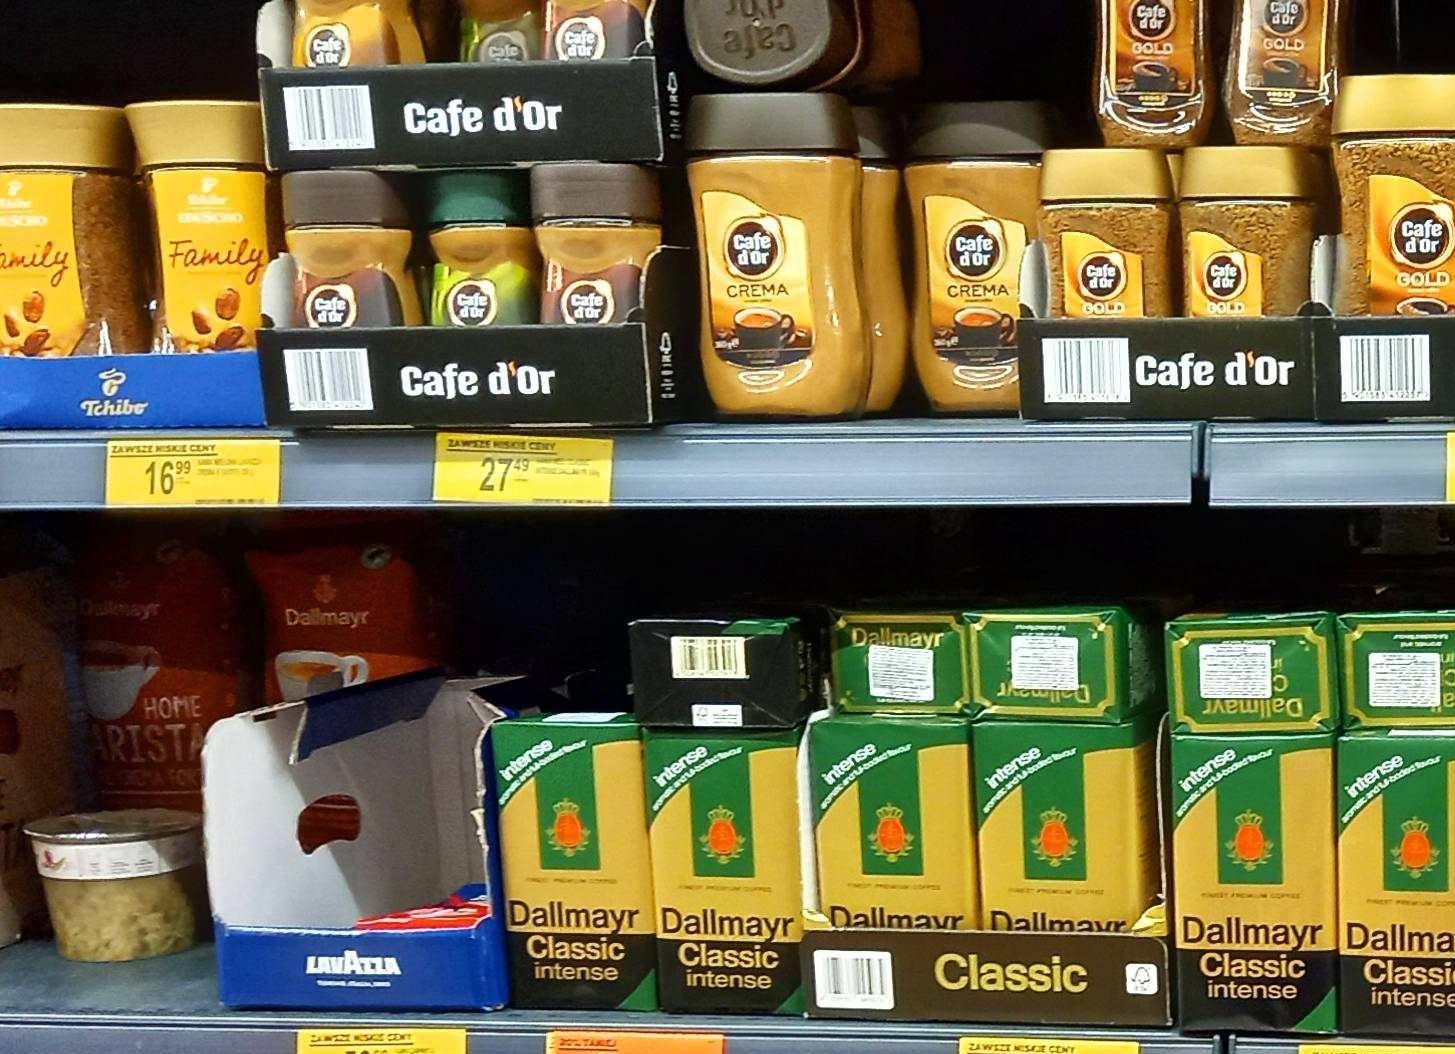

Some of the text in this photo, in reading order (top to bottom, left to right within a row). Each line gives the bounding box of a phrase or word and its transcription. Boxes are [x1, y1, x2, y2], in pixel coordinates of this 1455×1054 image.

[1132, 41, 1173, 56] GOLD
[1262, 36, 1304, 51] GOLD
[403, 97, 562, 137] Cafe d'Or
[168, 241, 266, 286] Family
[726, 284, 789, 298] CREMA
[947, 284, 1009, 298] CREMA
[1396, 272, 1450, 288] GOLD
[400, 362, 555, 399] Cafe d'Or
[1135, 353, 1294, 390] Cafe d'Or
[81, 401, 148, 417] Tchibo
[448, 440, 555, 450] ZAWSZE NISKIE CENY
[145, 461, 174, 494] 16
[176, 462, 191, 474] 99
[480, 458, 511, 491] 27
[512, 459, 529, 471] 49
[285, 608, 370, 628] Dallmayr
[144, 696, 201, 719] HOME
[500, 740, 553, 781] intense
[654, 745, 709, 787] intense
[985, 747, 1042, 790] intense
[509, 900, 639, 935] Dallmayr
[661, 908, 794, 944] Dallmayr
[1183, 917, 1323, 950] Dallmayr
[527, 936, 625, 960] Classic
[678, 944, 779, 968] Classic
[306, 950, 401, 974] LAVAZZA
[535, 963, 619, 980] intense
[934, 953, 1088, 993] Classic
[1200, 954, 1306, 978] Classic
[686, 970, 772, 989] intense
[1208, 981, 1298, 999] intense
